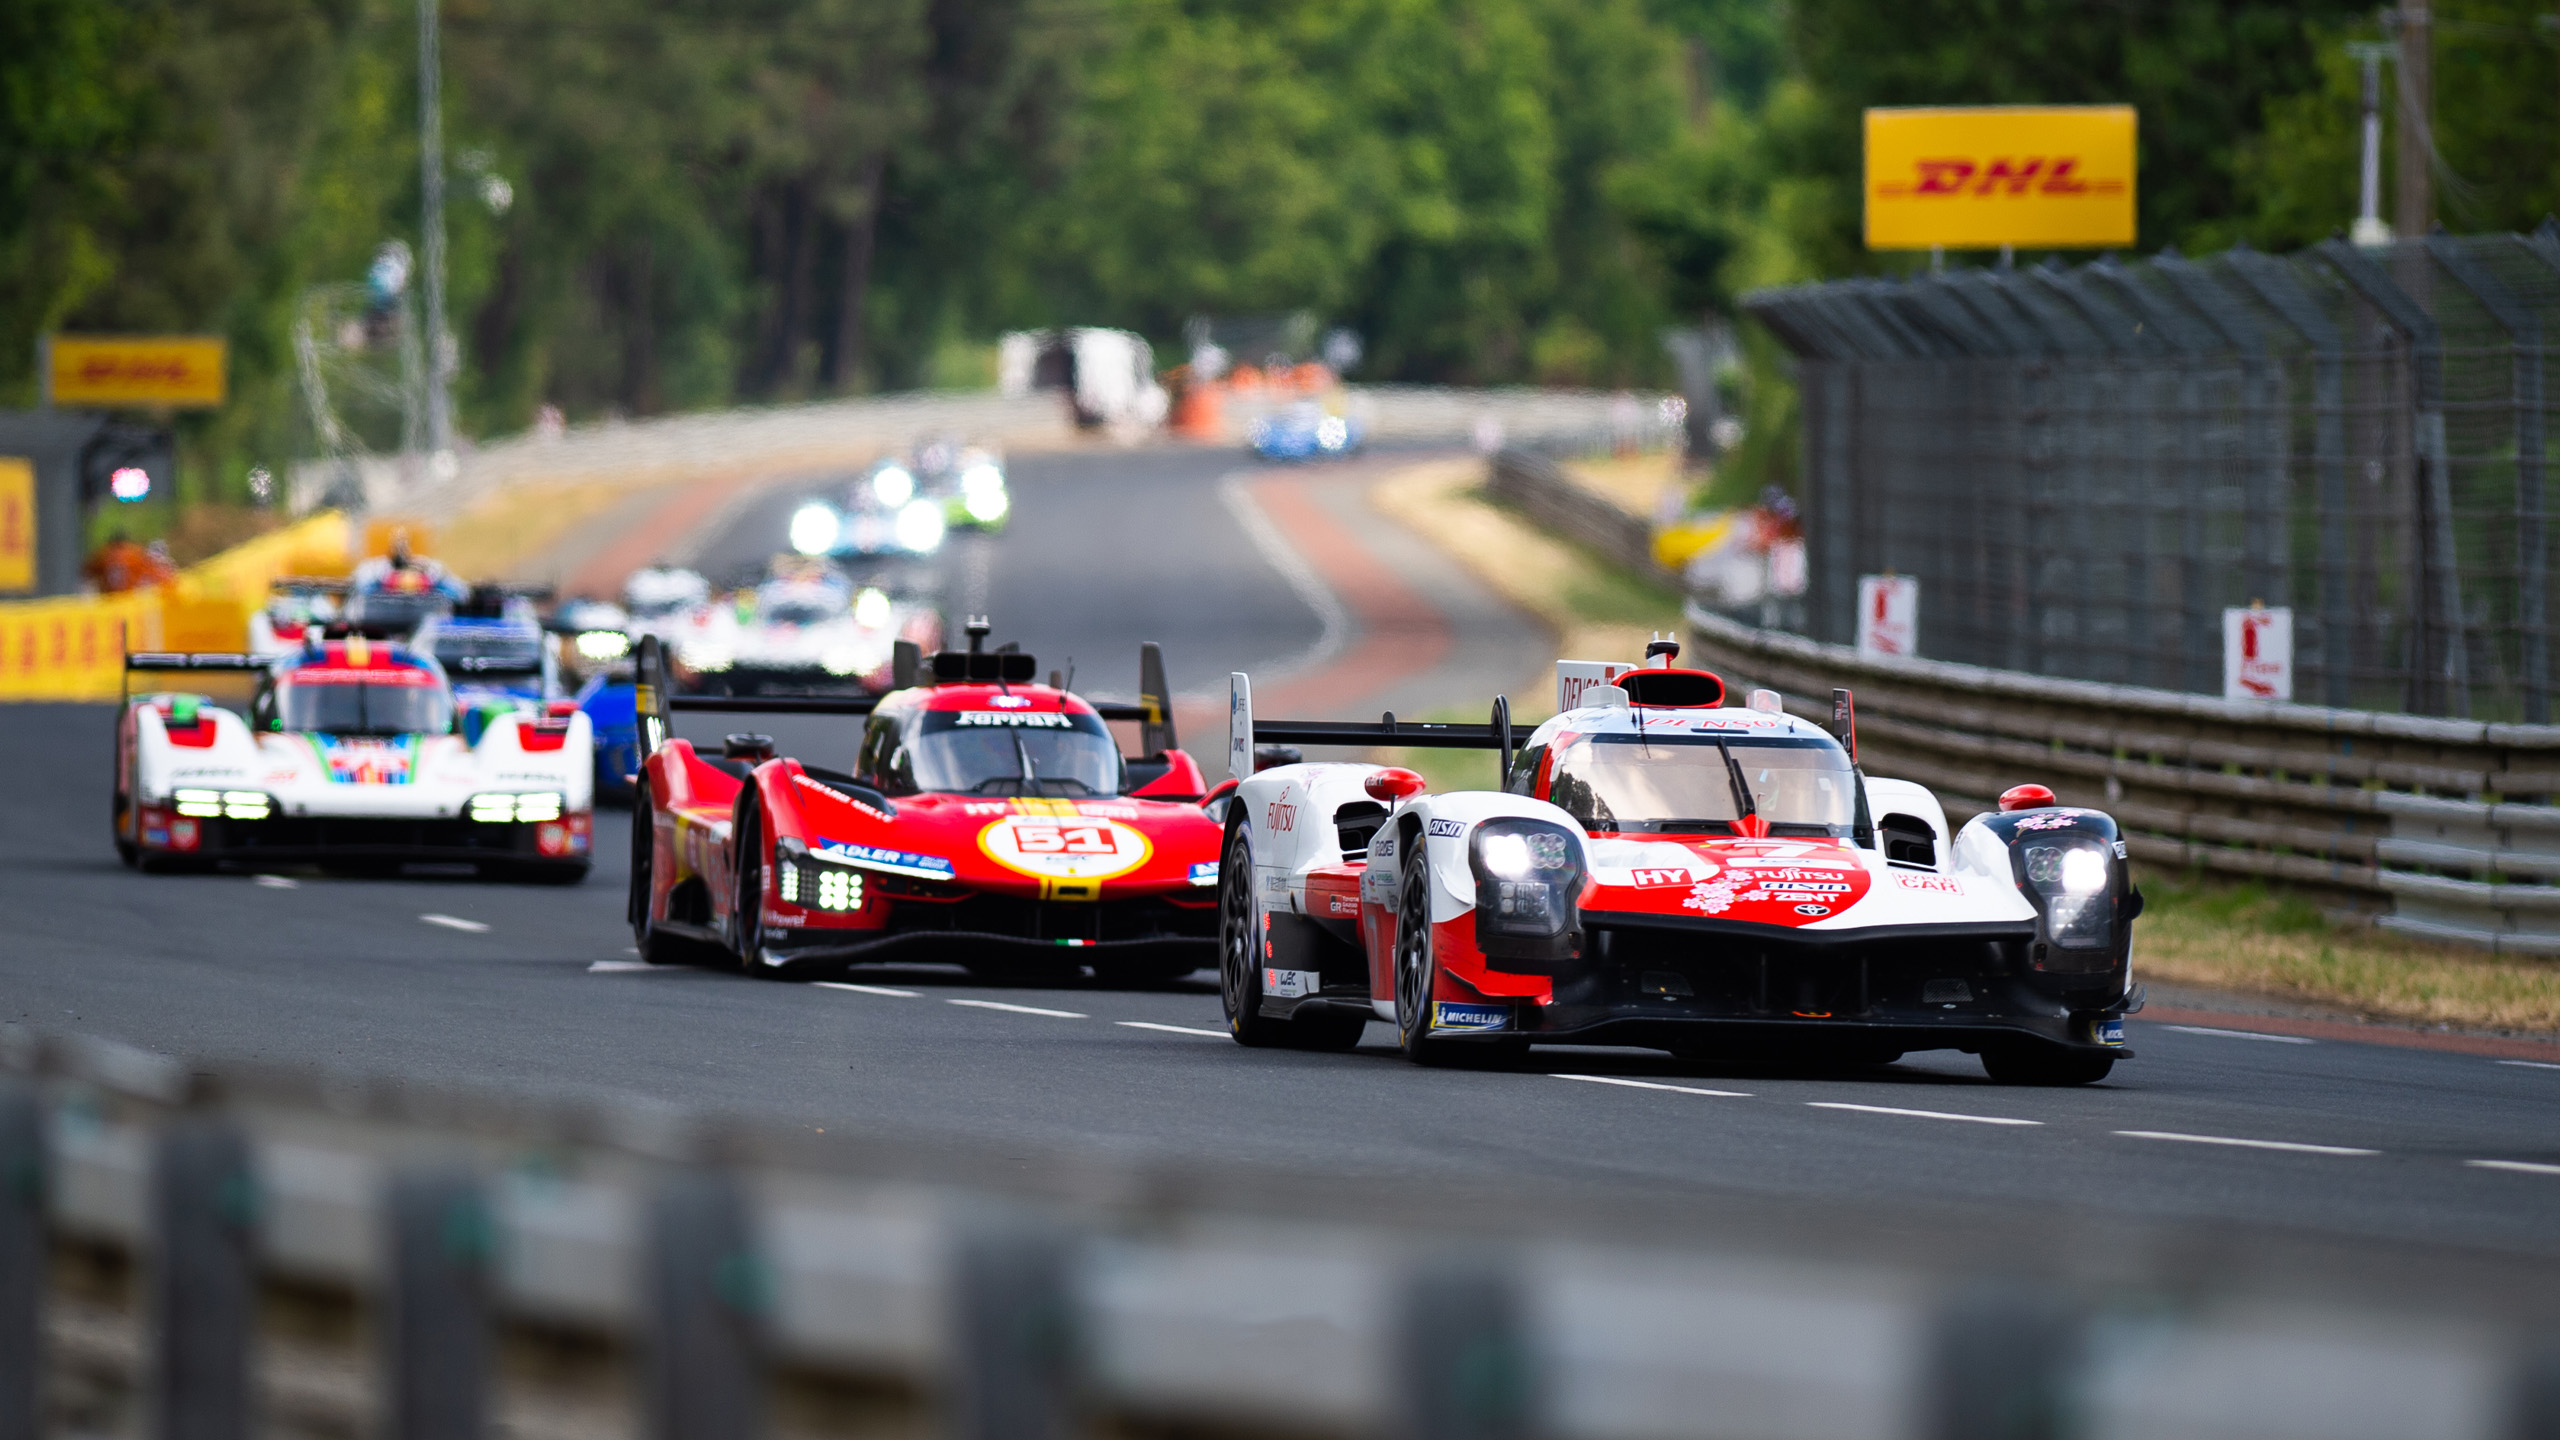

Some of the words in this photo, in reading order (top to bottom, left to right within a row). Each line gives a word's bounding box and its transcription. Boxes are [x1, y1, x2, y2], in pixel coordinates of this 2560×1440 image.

[1914, 155, 2087, 197] DHL
[1561, 676, 1600, 713] DEN
[955, 711, 1073, 728] Ferrari
[1643, 718, 1776, 729] DENSO
[1266, 801, 1297, 839] FUJITSU
[1429, 819, 1465, 837] AISIN
[1015, 826, 1117, 853] 51
[826, 843, 901, 864] ADLER
[1633, 869, 1687, 885] HY
[1753, 868, 1844, 881] FUJITSU
[1901, 879, 1957, 893] CAR
[1773, 892, 1840, 902] ZENT
[1446, 1010, 1503, 1024] MICHELIN
